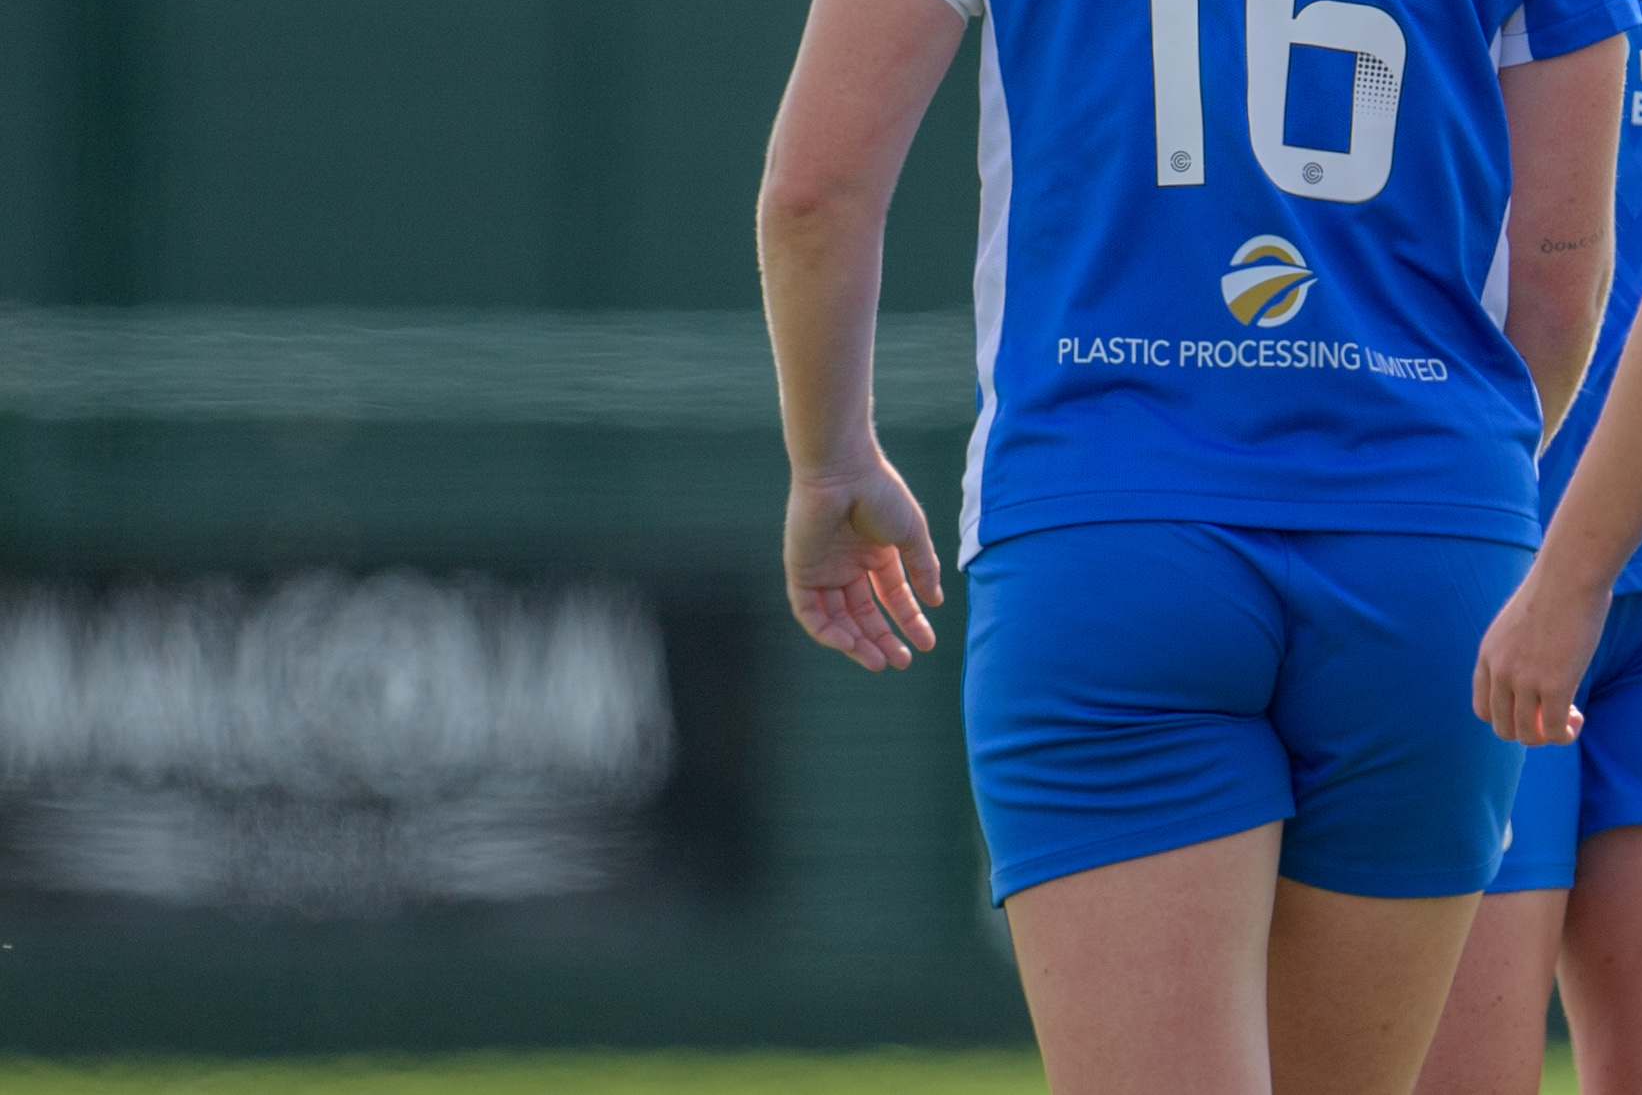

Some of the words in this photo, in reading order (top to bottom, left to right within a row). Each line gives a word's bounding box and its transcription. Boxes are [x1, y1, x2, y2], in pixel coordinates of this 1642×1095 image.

[1057, 337, 1170, 366] PLASTIC
[1179, 340, 1361, 370] PROCESSING
[1364, 346, 1448, 382] LIMITED
